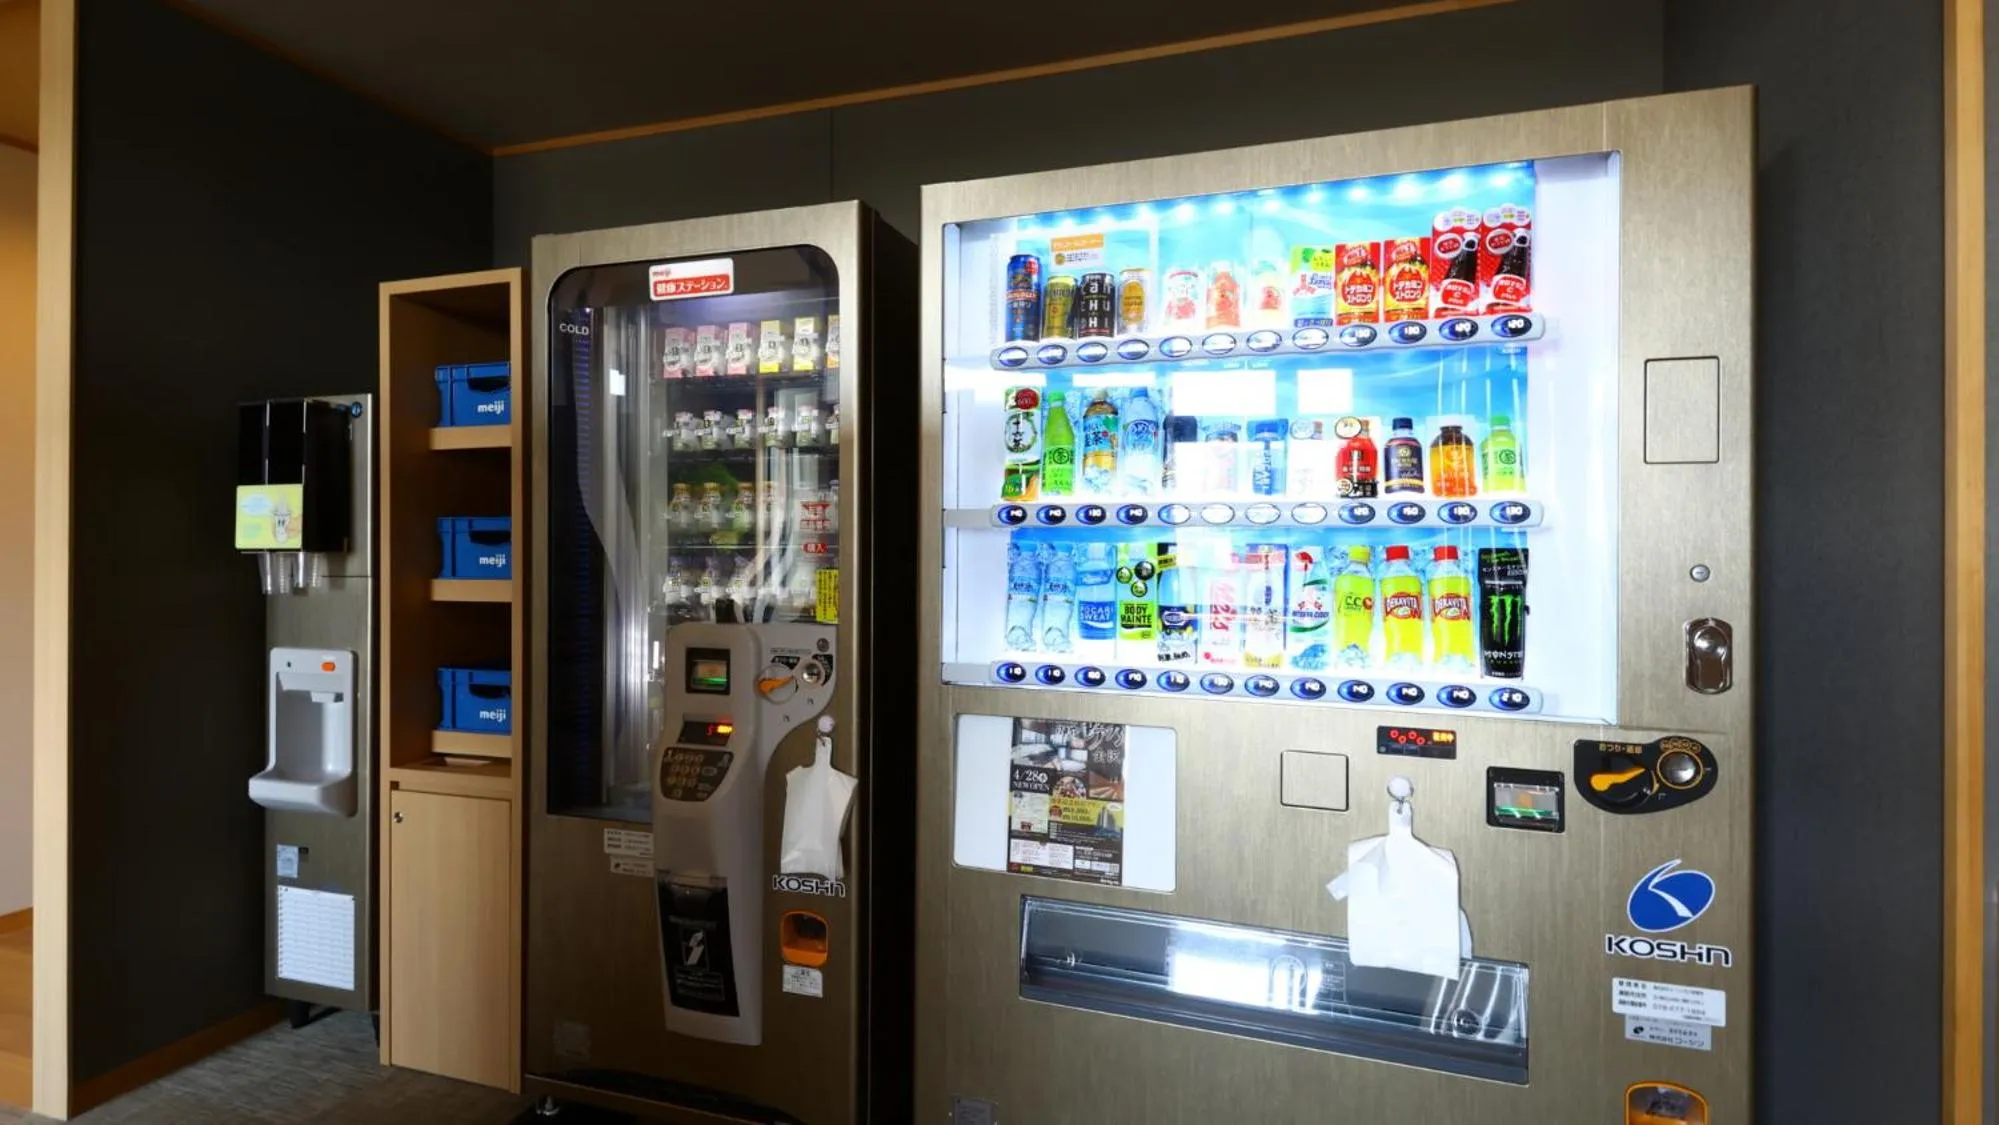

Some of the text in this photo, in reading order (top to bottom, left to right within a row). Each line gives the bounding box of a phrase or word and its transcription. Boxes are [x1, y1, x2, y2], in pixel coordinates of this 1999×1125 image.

[559, 323, 589, 336] COLD
[478, 401, 504, 414] meiji
[479, 554, 506, 567] meiji
[1080, 605, 1114, 614] POCARI
[1124, 605, 1148, 614] BODY
[1080, 613, 1110, 621] SWEAT
[1120, 614, 1152, 623] MAINTE
[480, 708, 506, 721] meiji
